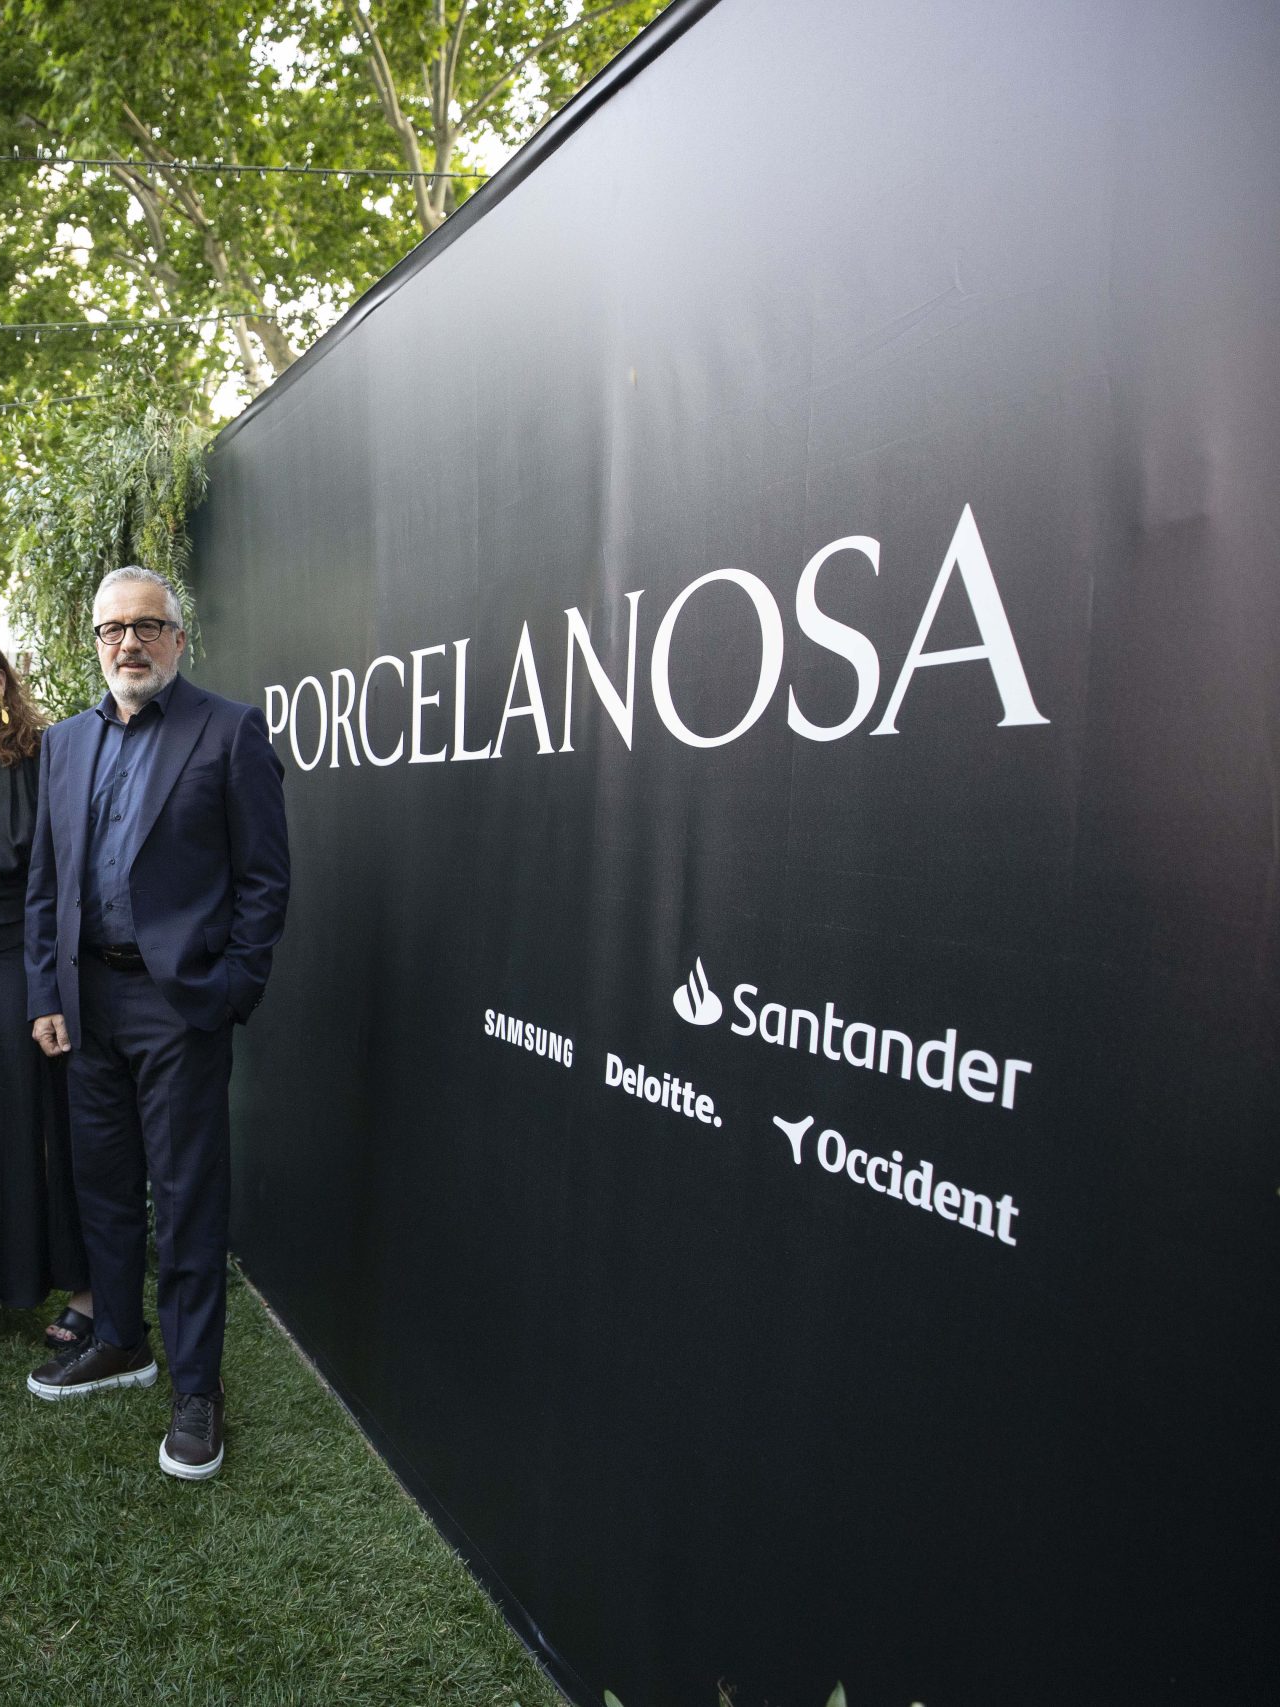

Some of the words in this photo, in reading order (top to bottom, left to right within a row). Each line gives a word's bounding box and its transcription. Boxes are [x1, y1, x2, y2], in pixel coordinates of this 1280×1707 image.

[264, 502, 1051, 772] PORCELANOSA
[484, 1008, 574, 1068] SAMSUNG
[605, 1052, 723, 1128] Deloitte.
[730, 983, 1033, 1110] Santander
[817, 1129, 1019, 1246] Occident
